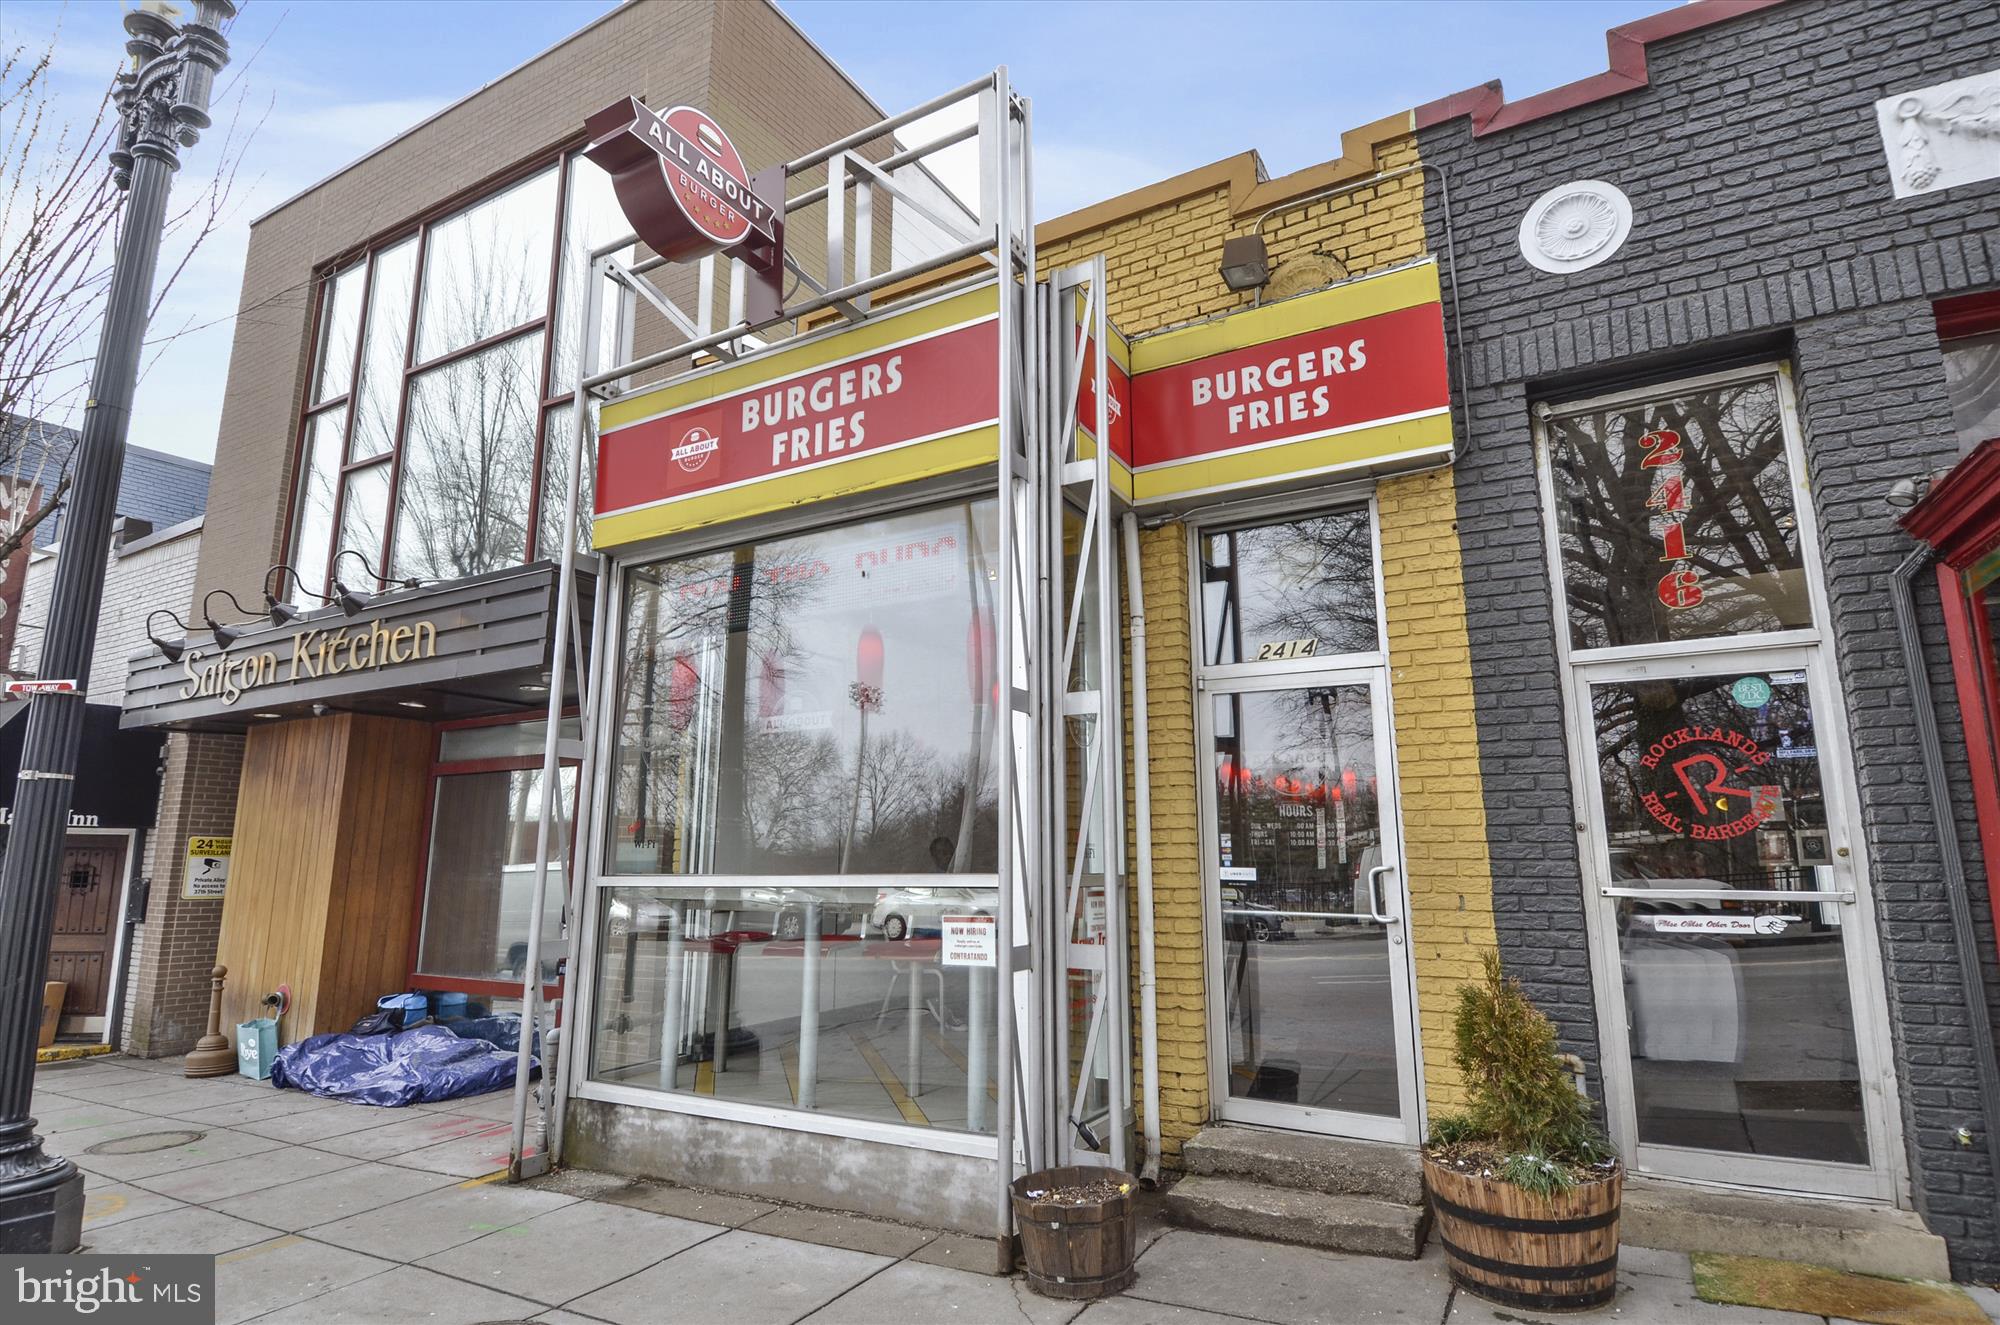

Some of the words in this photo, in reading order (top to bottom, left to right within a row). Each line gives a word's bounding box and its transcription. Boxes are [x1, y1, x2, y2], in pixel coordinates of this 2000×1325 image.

[648, 121, 690, 165] ALL
[696, 158, 764, 220] ABOUT
[679, 173, 736, 223] BURGER
[741, 355, 903, 433] BURGERS
[1191, 338, 1367, 407] BURGERS
[1228, 385, 1330, 434] FRIES
[675, 448, 689, 457] ALL
[689, 441, 714, 454] ABOUT
[772, 410, 865, 467] FRIES
[1638, 429, 1705, 610] 2416
[179, 650, 277, 706] Saigon
[287, 619, 437, 681] Kitchen
[1259, 639, 1315, 661] 2414
[1640, 726, 1770, 769] ROCKLANDS
[1279, 805, 1313, 817] HOURS
[1640, 791, 1683, 833] REAL
[1690, 784, 1780, 840] BARBEQUE
[196, 839, 213, 849] 24
[950, 927, 964, 936] NOW
[966, 927, 987, 936] HIRING
[950, 952, 988, 961] CONTRATANDO
